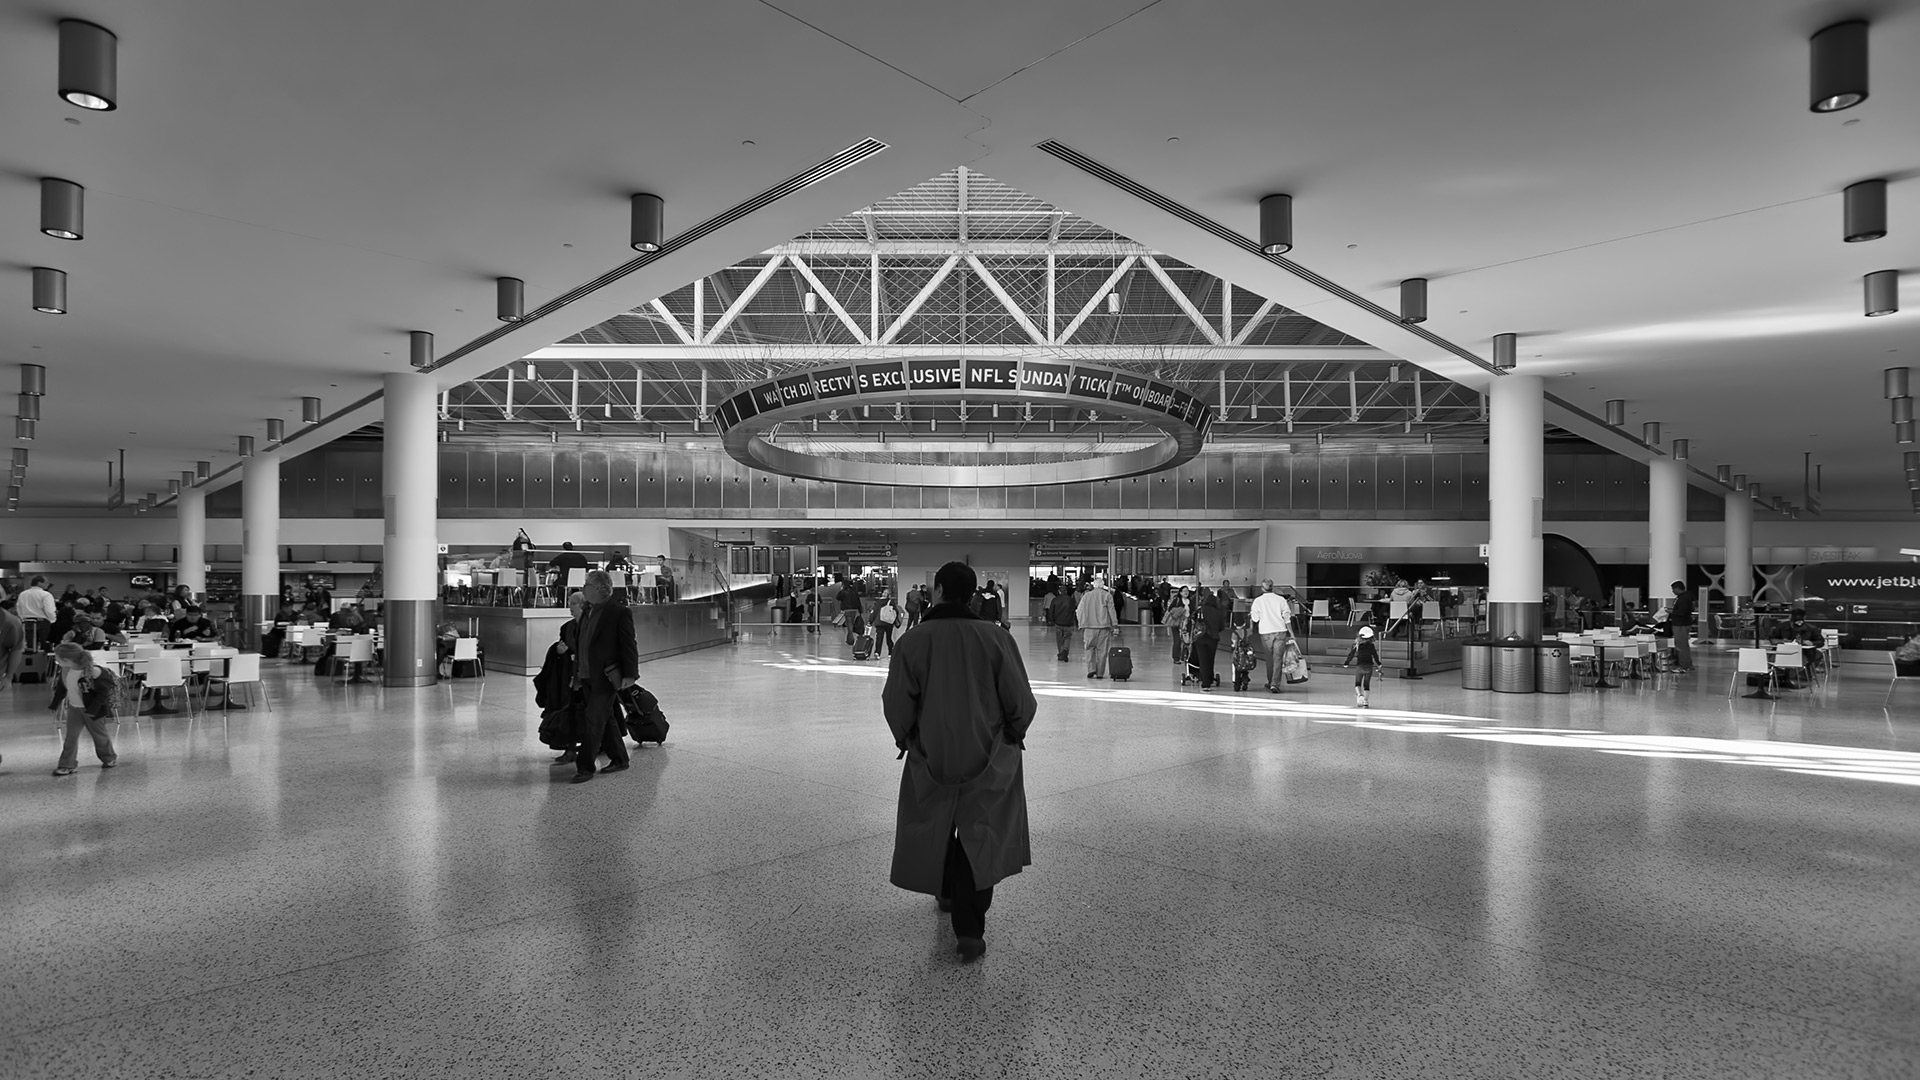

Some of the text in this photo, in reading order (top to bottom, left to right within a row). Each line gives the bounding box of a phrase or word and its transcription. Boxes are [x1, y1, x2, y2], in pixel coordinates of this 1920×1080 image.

[872, 368, 961, 387] EXCLUSIVE
[971, 368, 1004, 383] NFL
[1008, 369, 1077, 387] SUNDAY
